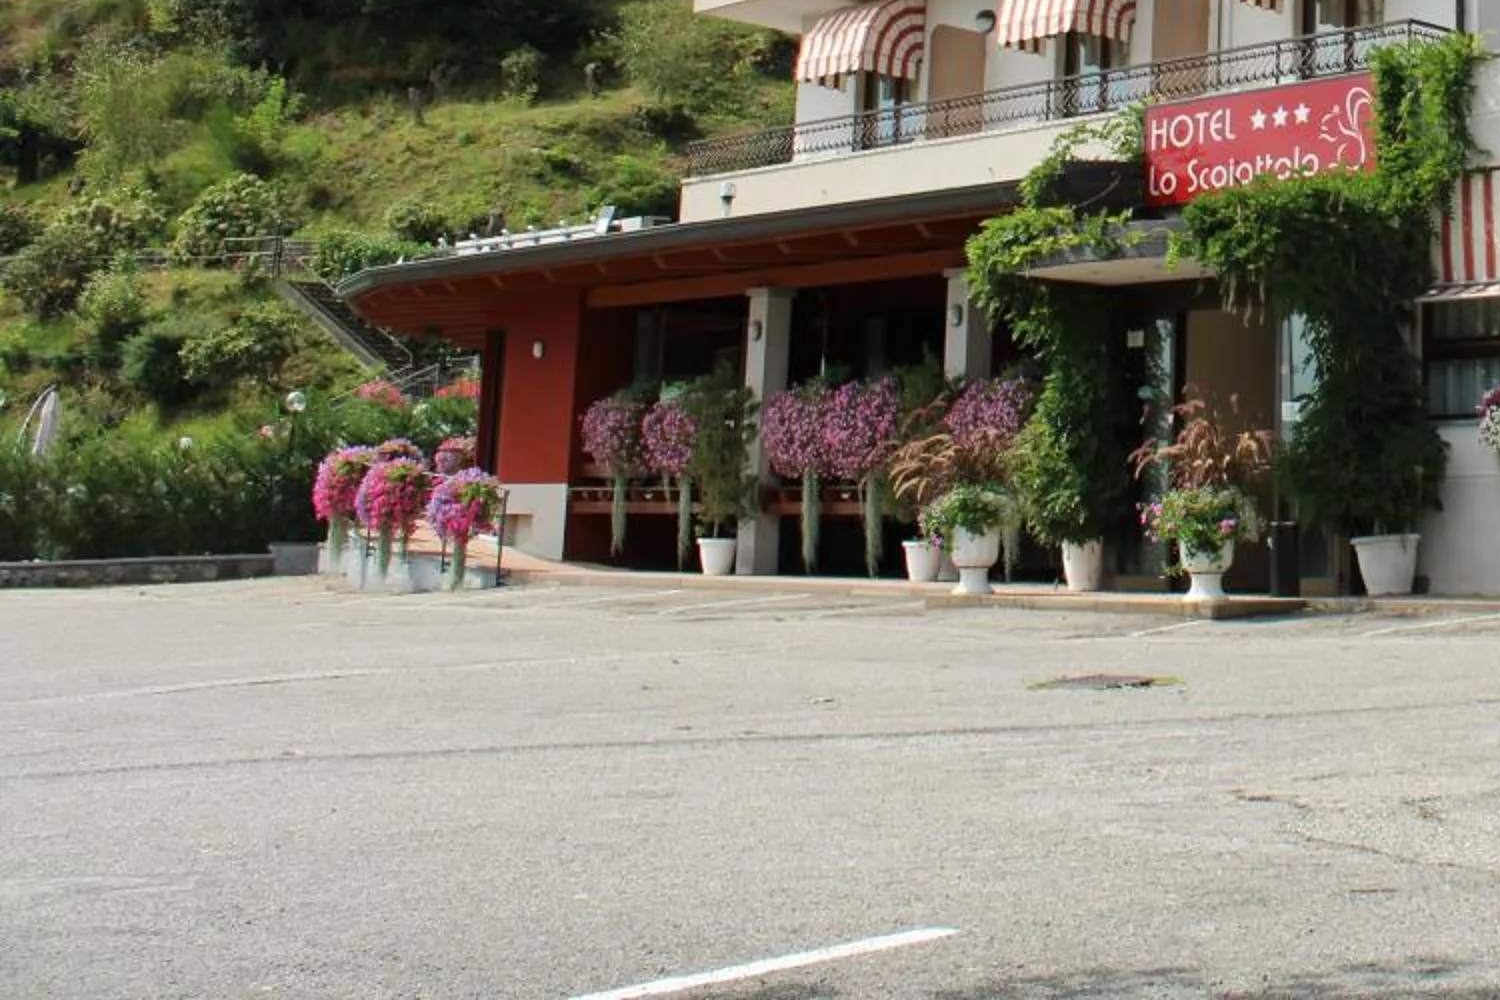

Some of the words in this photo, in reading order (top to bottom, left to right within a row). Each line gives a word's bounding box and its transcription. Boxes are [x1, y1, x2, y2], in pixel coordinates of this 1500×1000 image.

[1151, 108, 1236, 151] HOTEL
[1149, 165, 1177, 196] Lo
[1187, 145, 1319, 192] Scoiattolo
